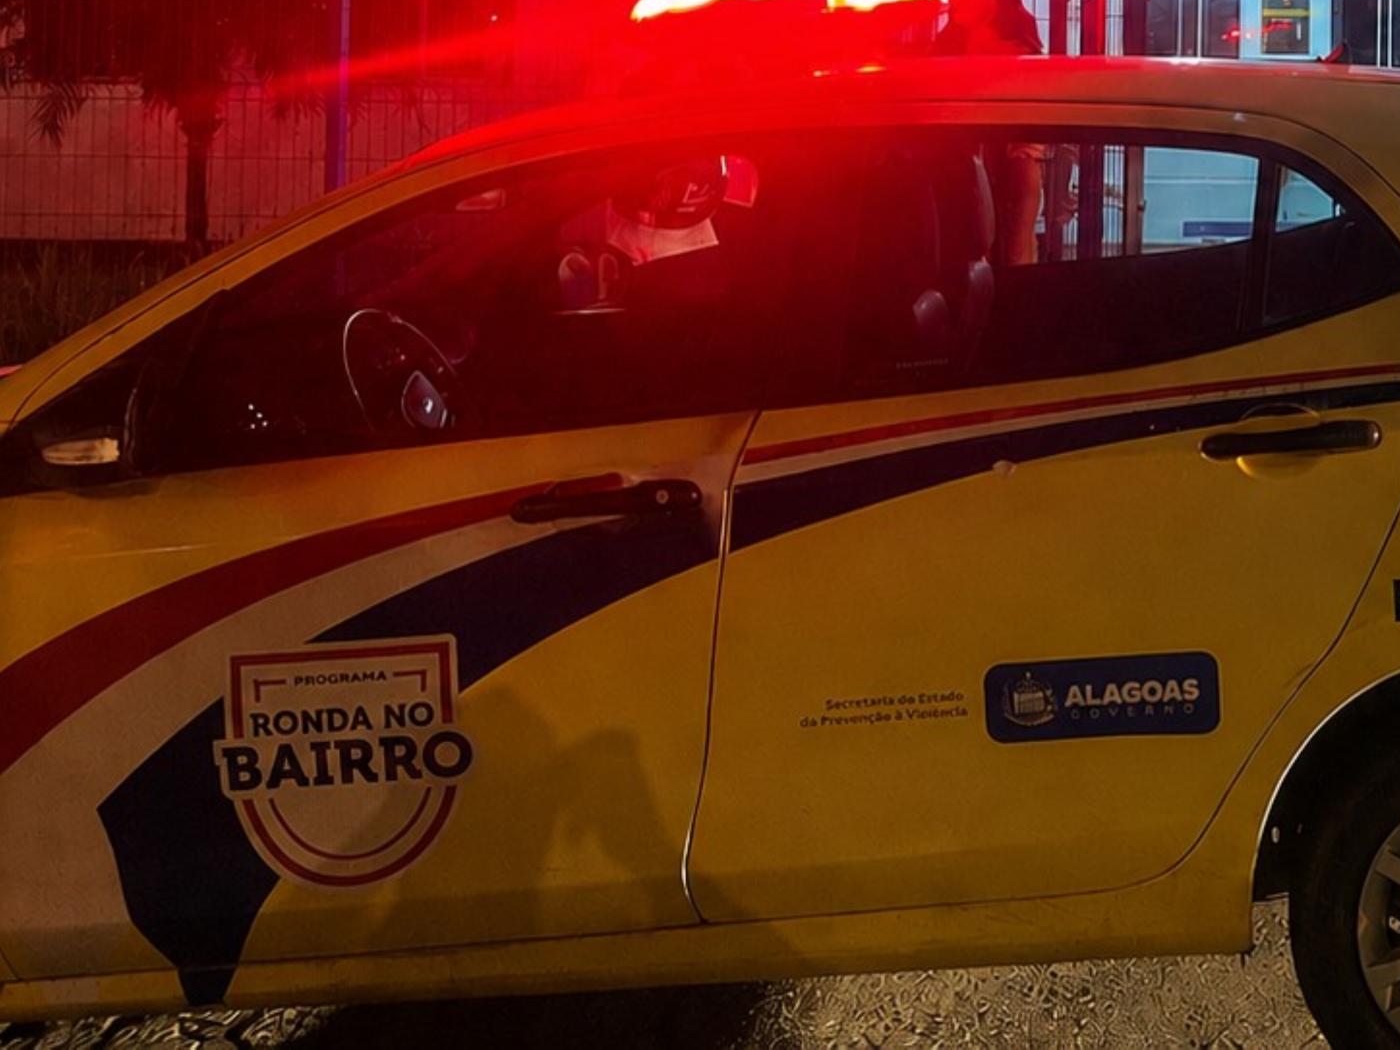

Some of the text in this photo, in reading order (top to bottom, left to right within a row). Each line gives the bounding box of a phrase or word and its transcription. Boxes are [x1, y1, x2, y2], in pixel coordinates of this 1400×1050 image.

[294, 669, 387, 687] PROGRAMA
[825, 694, 894, 711] Secretaria
[1064, 677, 1201, 708] ALAGOAS
[250, 701, 434, 738] RONDA NO
[1071, 702, 1195, 720] GOVERNO
[221, 730, 473, 792] BAIRRO
